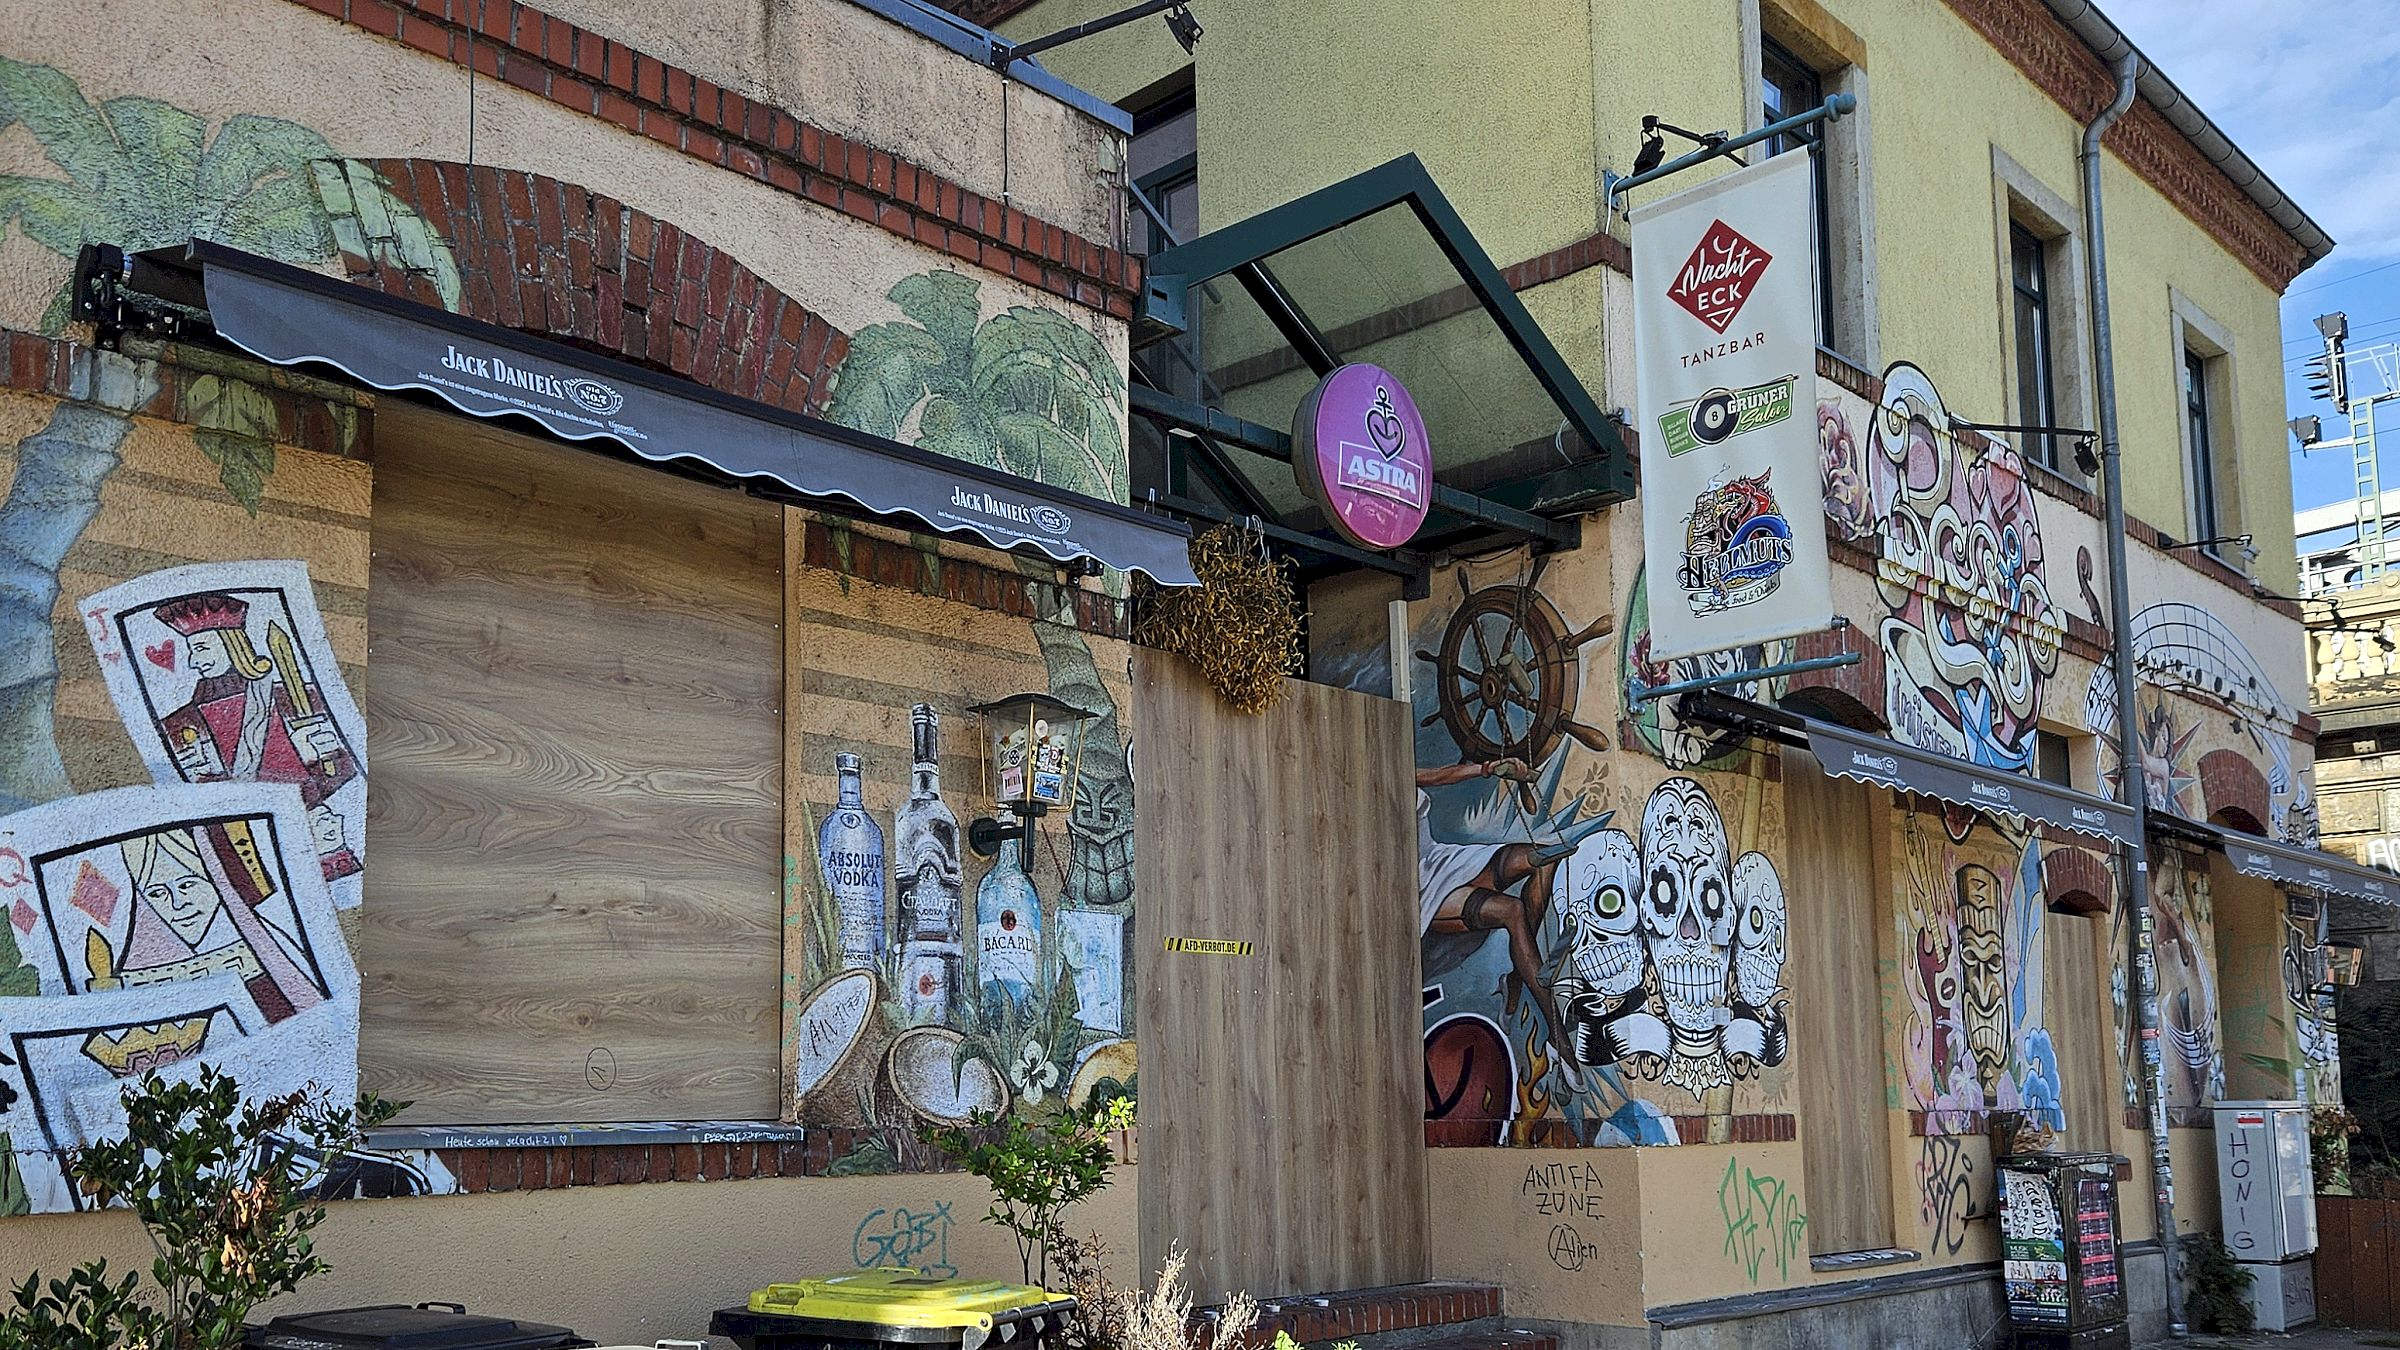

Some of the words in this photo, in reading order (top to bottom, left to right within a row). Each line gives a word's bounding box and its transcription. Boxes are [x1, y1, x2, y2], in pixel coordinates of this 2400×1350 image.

[1674, 235, 1762, 297] Nacht
[1697, 281, 1742, 311] ECK
[1681, 332, 1764, 369] TANZBAR
[1727, 386, 1788, 414] GRÜNER
[1741, 400, 1788, 430] Salon
[1711, 411, 1718, 422] 8
[1347, 455, 1417, 495] ASTRA
[1677, 538, 1793, 591] HELLMUTS
[827, 851, 881, 869] ABSOLUT
[833, 870, 879, 888] VODKA
[1185, 940, 1236, 953] AFD-VERBOT.DE
[445, 1136, 473, 1148] Heute
[1522, 1161, 1604, 1195] ANTIFA
[2228, 1129, 2256, 1250] HONIG
[1536, 1193, 1606, 1220] ZONE
